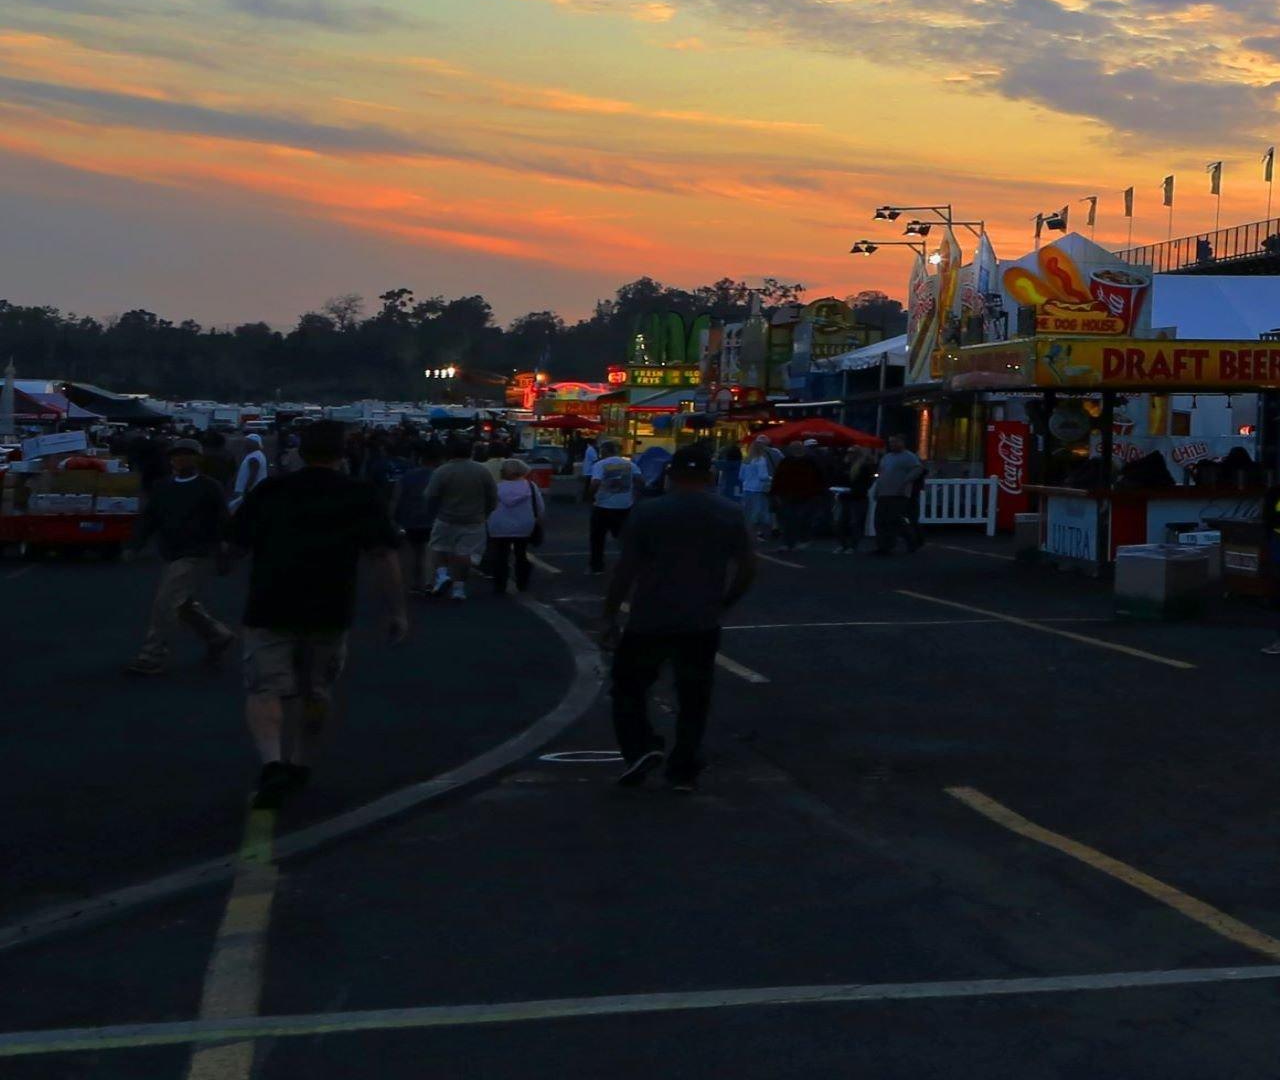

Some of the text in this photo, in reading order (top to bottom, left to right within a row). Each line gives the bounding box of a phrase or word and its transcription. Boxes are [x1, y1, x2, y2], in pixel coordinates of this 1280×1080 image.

[1054, 319, 1077, 330] DOG
[1083, 319, 1117, 331] HOUSE
[1102, 348, 1210, 381] DRAFT
